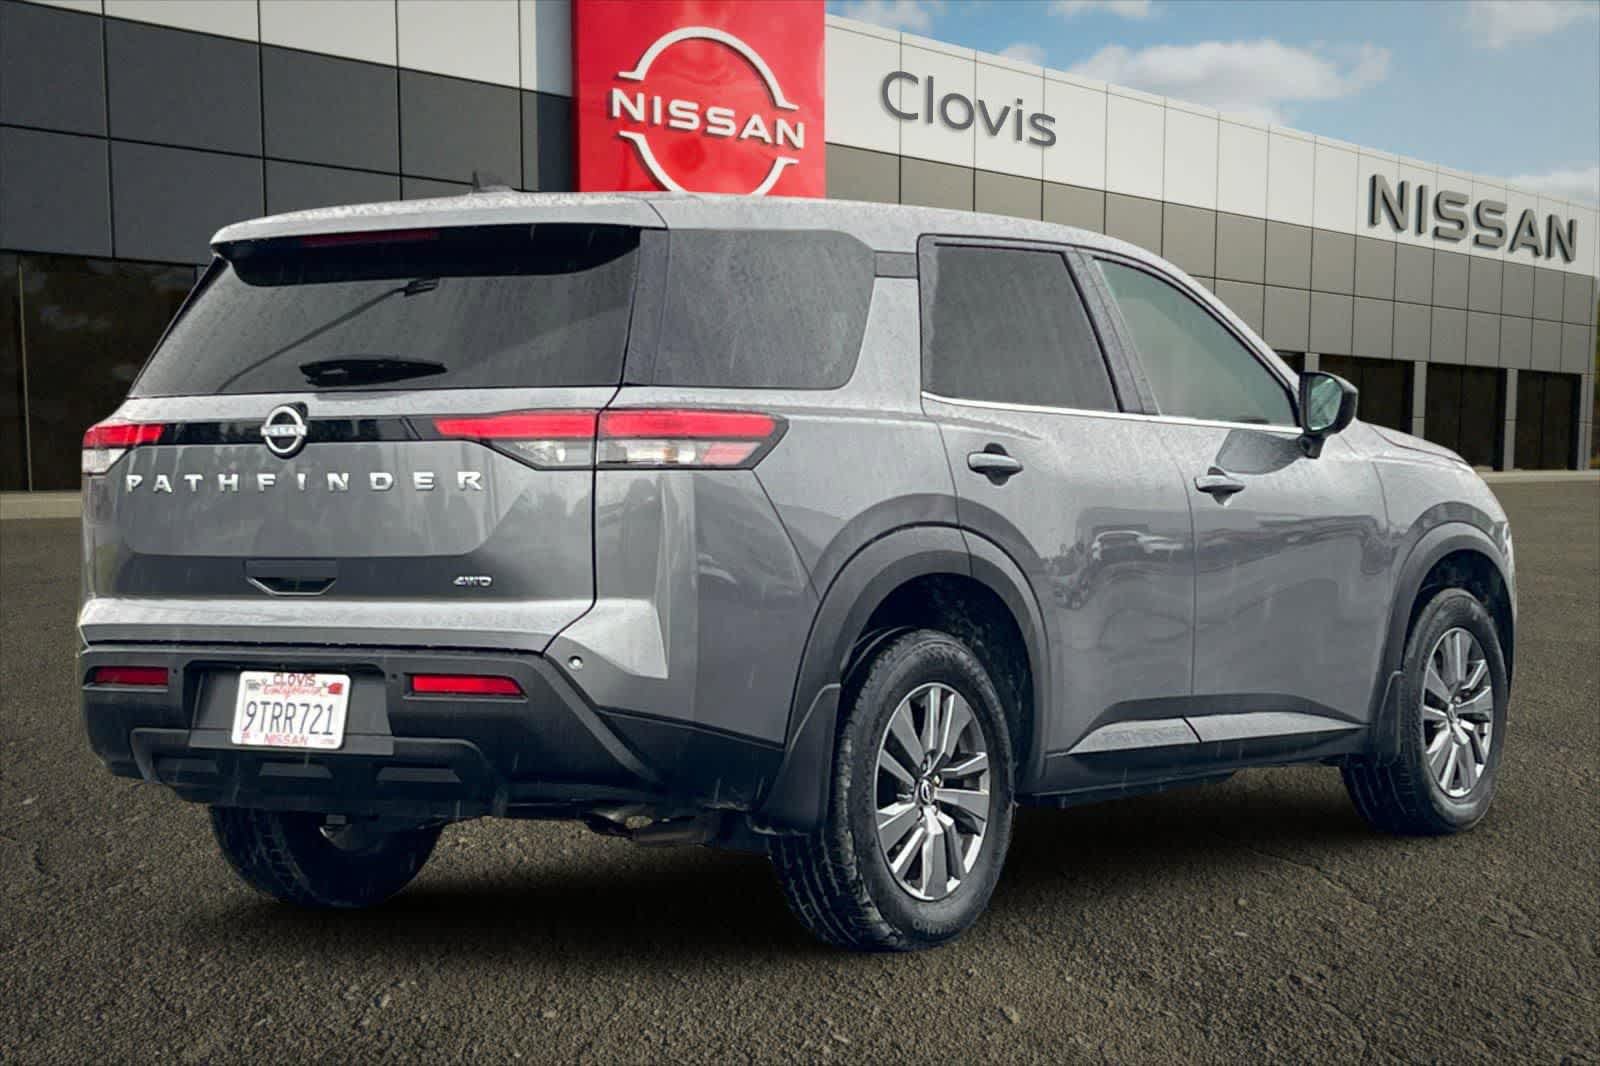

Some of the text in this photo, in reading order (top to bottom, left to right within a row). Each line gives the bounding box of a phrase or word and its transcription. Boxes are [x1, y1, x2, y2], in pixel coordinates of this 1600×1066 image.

[610, 87, 806, 149] NISSAN
[880, 70, 1058, 148] Clovis
[1368, 173, 1578, 263] NISSAN
[125, 470, 486, 494] PATHFINDER
[453, 575, 493, 587] 4WD
[272, 673, 317, 687] CLOVIS
[243, 701, 334, 735] 9TRR721
